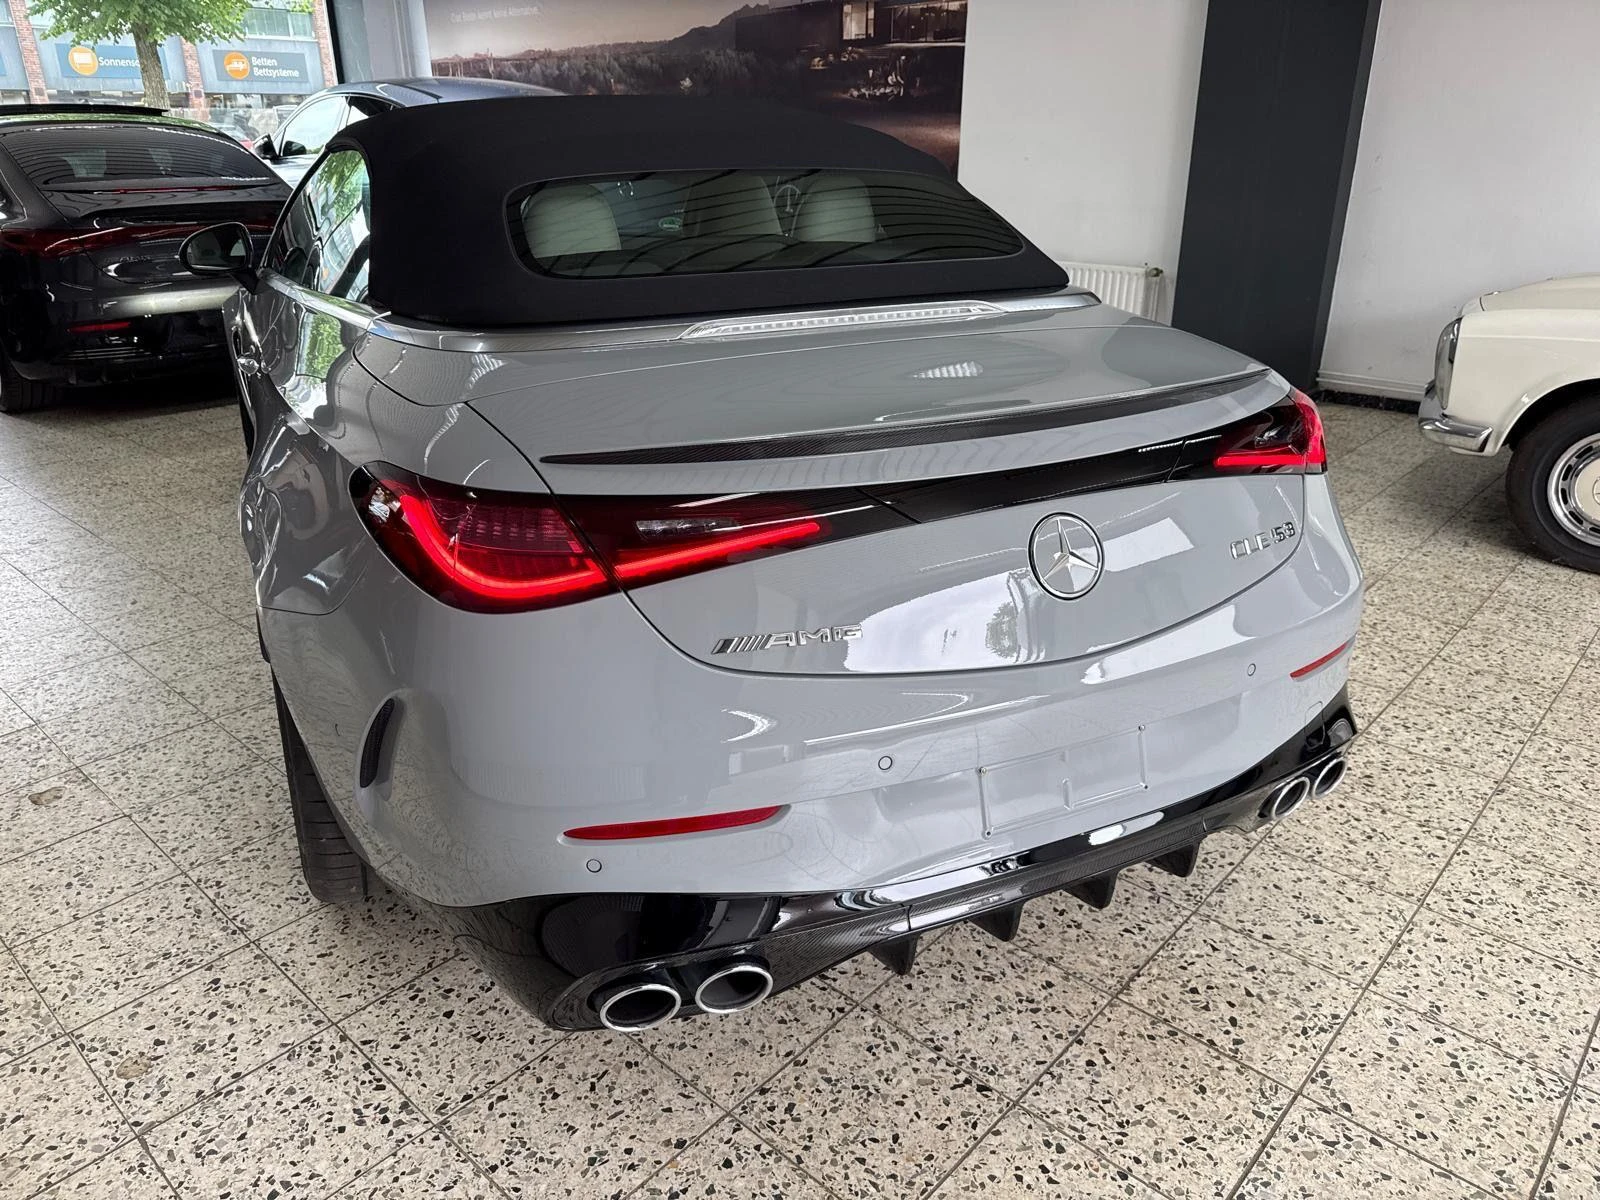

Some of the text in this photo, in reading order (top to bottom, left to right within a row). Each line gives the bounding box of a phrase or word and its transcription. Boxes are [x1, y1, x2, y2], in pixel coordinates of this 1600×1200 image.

[251, 56, 278, 67] Betten
[253, 66, 300, 78] Bettsysteme
[764, 624, 863, 649] AMG
